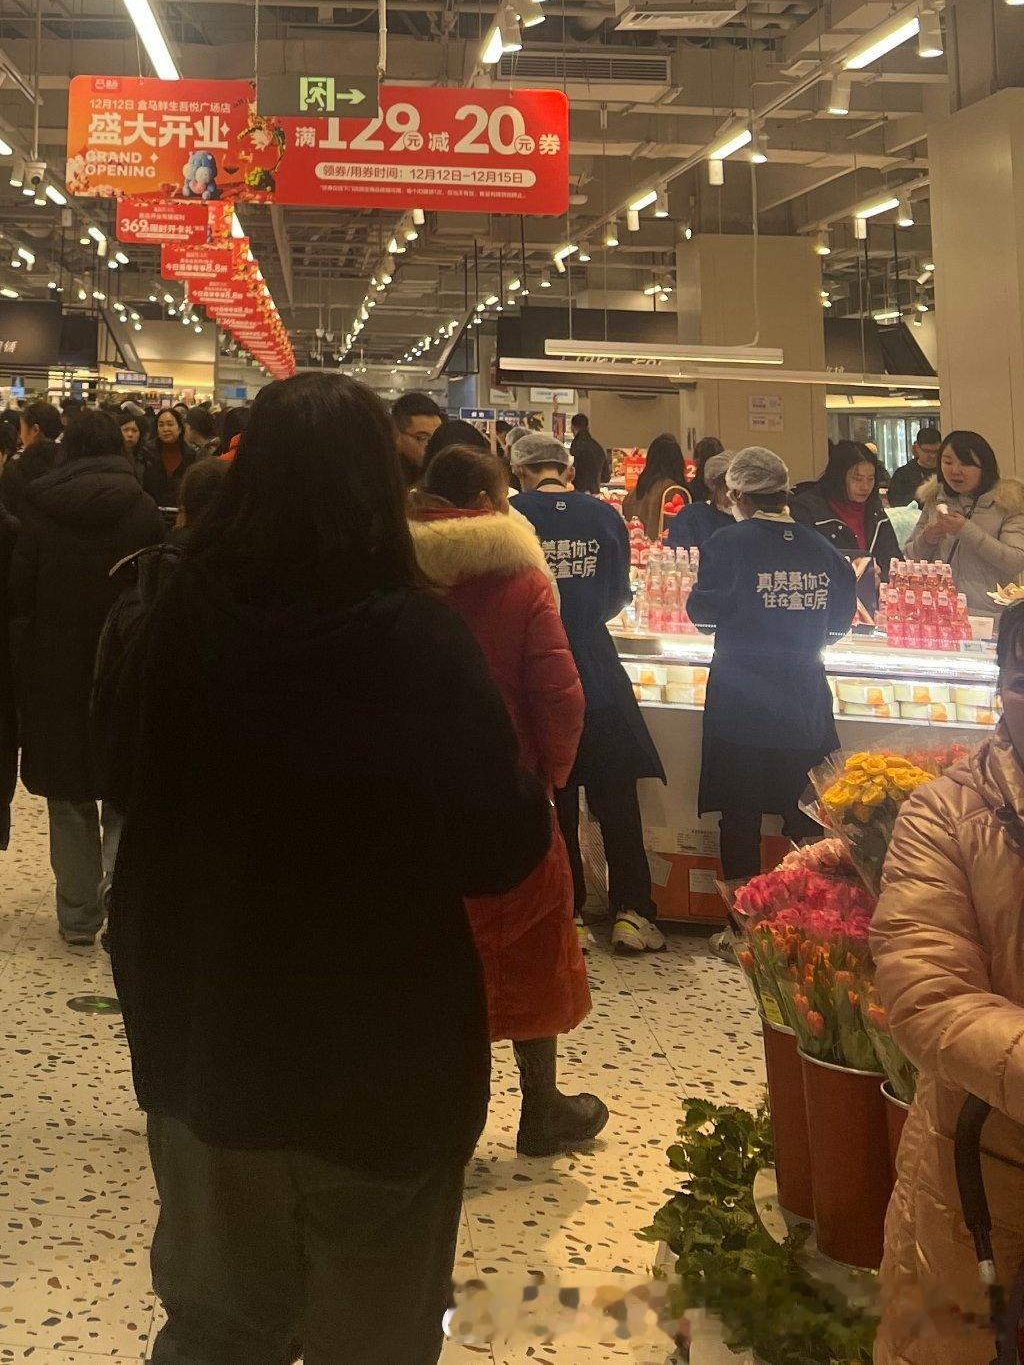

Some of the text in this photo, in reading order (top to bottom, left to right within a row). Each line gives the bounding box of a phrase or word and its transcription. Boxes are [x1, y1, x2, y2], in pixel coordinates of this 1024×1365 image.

[89, 98, 232, 114] 12月12日 盒马鲜生吾悦广场店
[88, 112, 229, 149] 盛大开业
[85, 150, 142, 164] GRAND
[84, 164, 156, 178] OPENING
[756, 570, 819, 591] 真羡慕你
[763, 590, 828, 611] 住在盒区房
